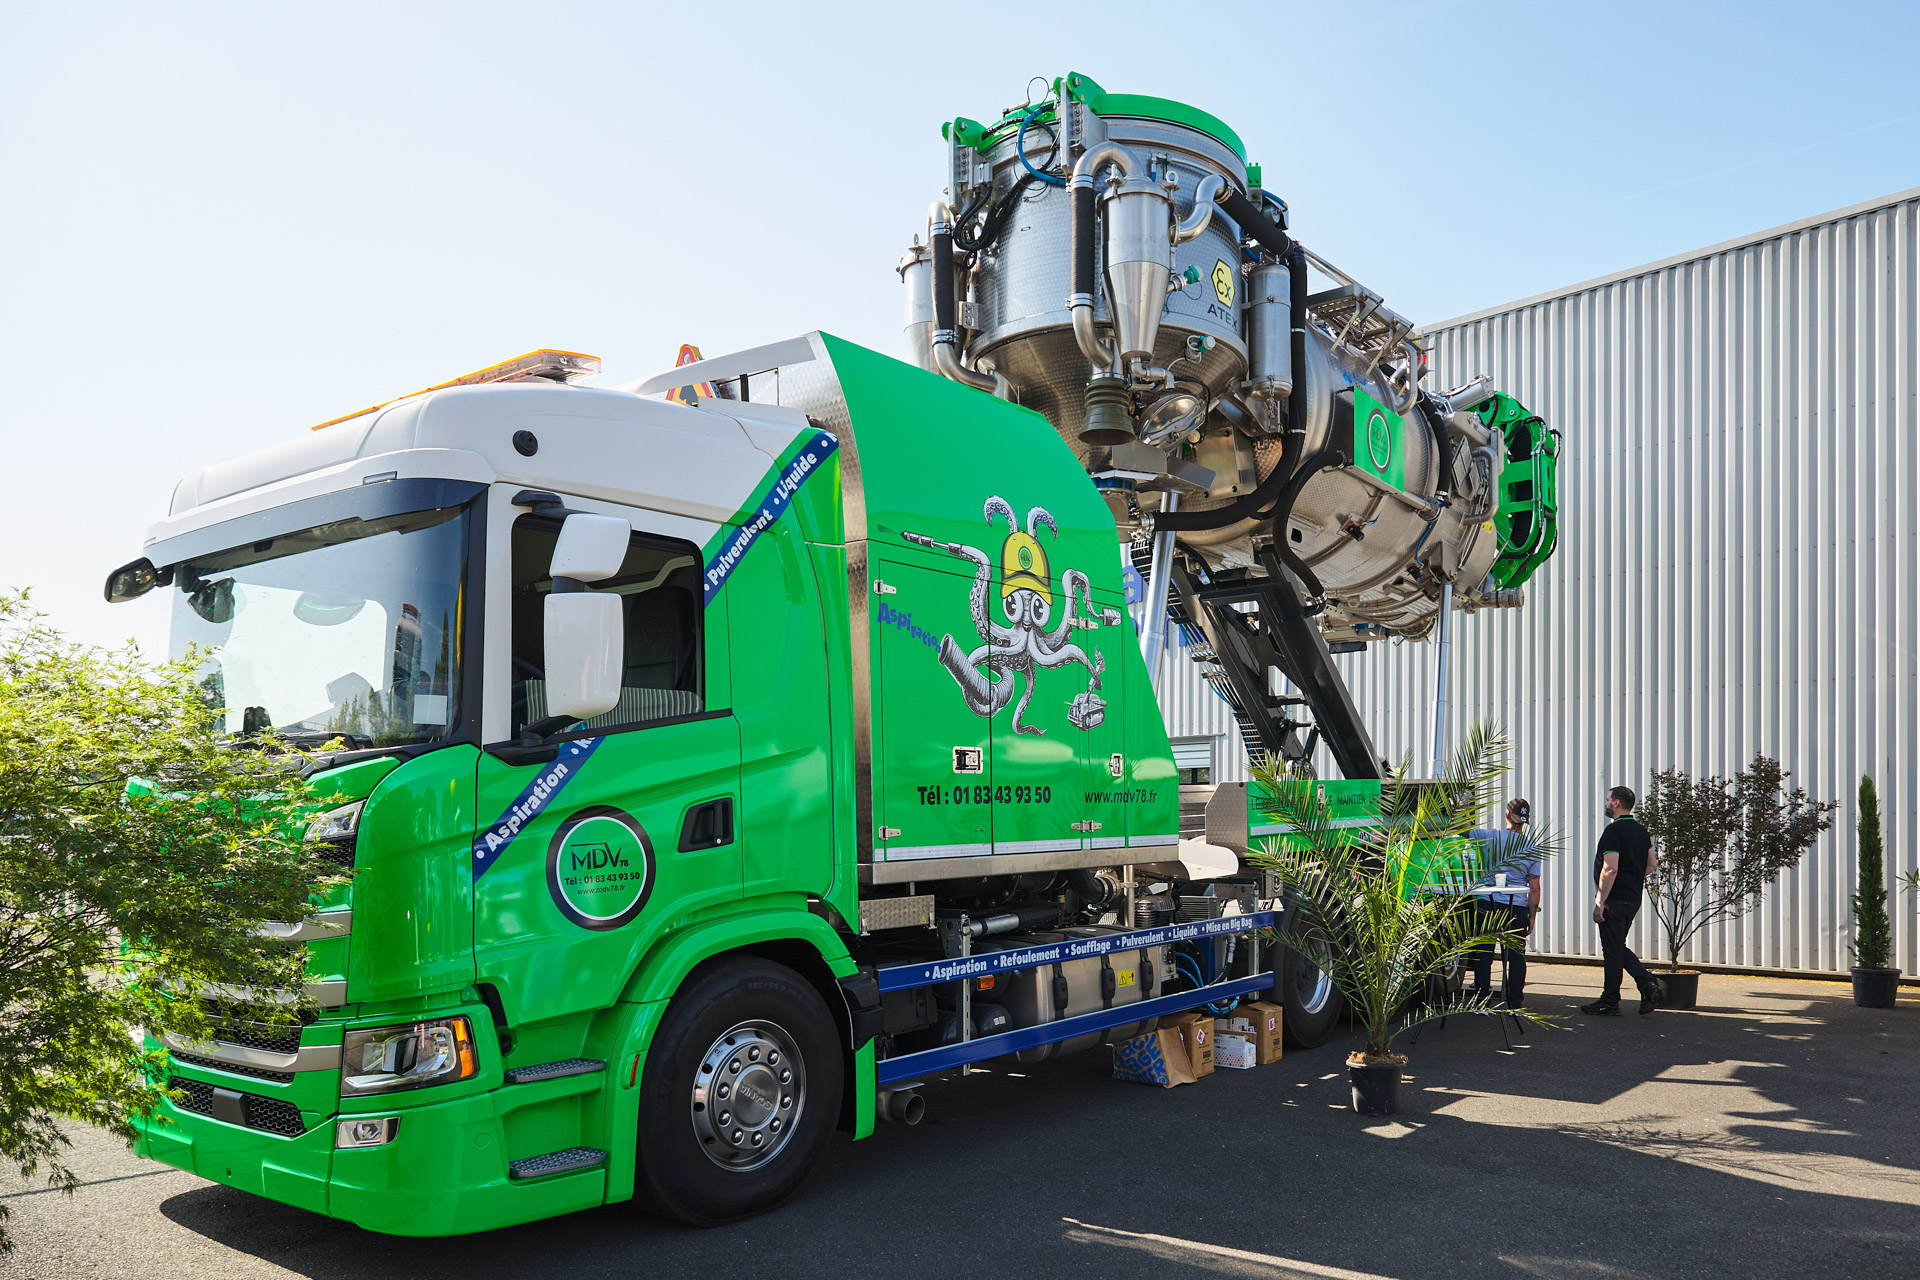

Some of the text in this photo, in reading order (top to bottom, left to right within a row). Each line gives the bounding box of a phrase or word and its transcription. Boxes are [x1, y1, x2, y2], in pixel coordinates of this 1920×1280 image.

[1207, 303, 1238, 332] ATEX
[707, 453, 818, 586] Pulverulent Liquide
[877, 602, 941, 653] Aspiration
[484, 763, 569, 853] Aspiration
[917, 785, 941, 805] Tél
[953, 785, 969, 804] 01
[973, 785, 991, 804] 83
[994, 785, 1011, 804] 43
[1015, 785, 1031, 804] 93
[1034, 785, 1051, 804] 50
[1084, 789, 1157, 803] www.mdv78.fr
[577, 884, 626, 895] www.mdv78.fr
[583, 876, 593, 884] 01
[595, 875, 605, 883] 83
[606, 874, 617, 882] 43
[618, 873, 628, 881] 93
[630, 872, 640, 880] 50
[932, 917, 1253, 980] Aspiration Refoulement Soufflage Pulverulent Liquide Mise en Big Bag
